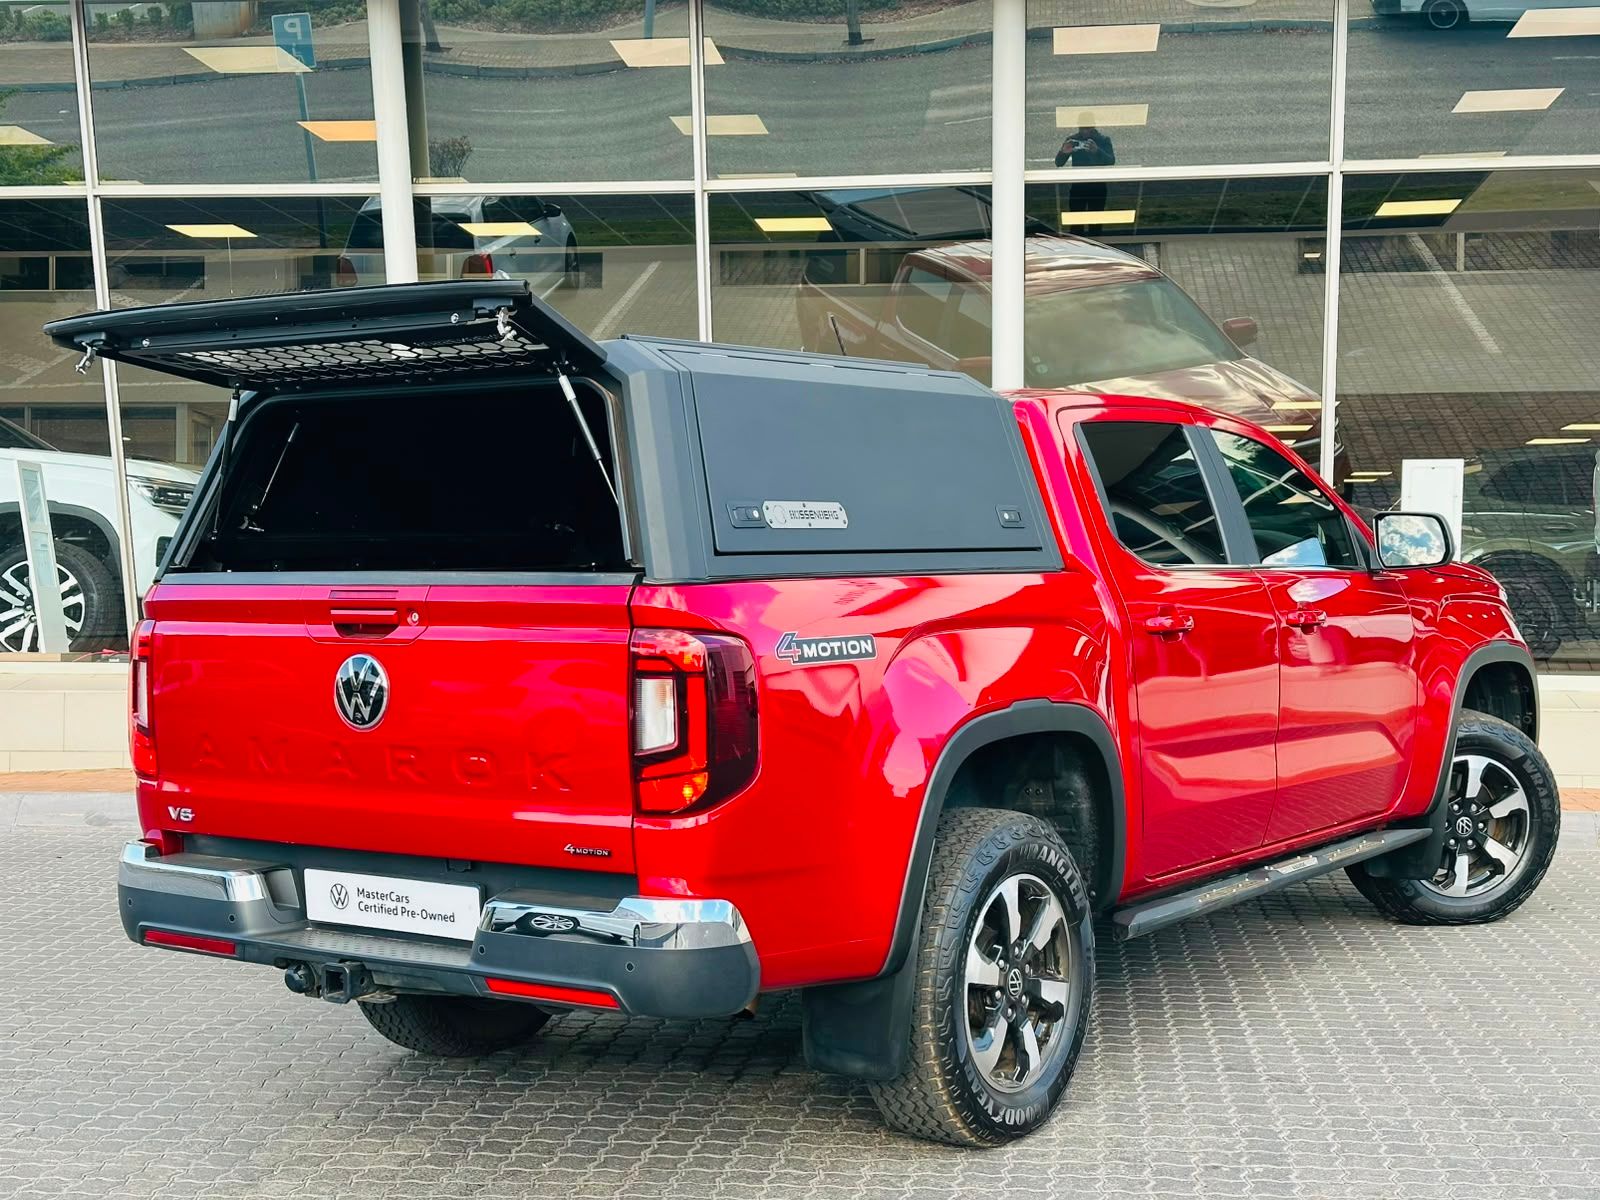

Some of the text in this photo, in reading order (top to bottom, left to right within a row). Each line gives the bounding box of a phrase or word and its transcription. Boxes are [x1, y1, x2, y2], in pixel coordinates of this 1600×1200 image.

[776, 632, 875, 663] 4MOTION
[193, 732, 573, 792] AMAROK
[564, 843, 609, 856] 4MOTION
[357, 887, 410, 904] MasterCars
[358, 901, 455, 923] Certified Pre-Owned
